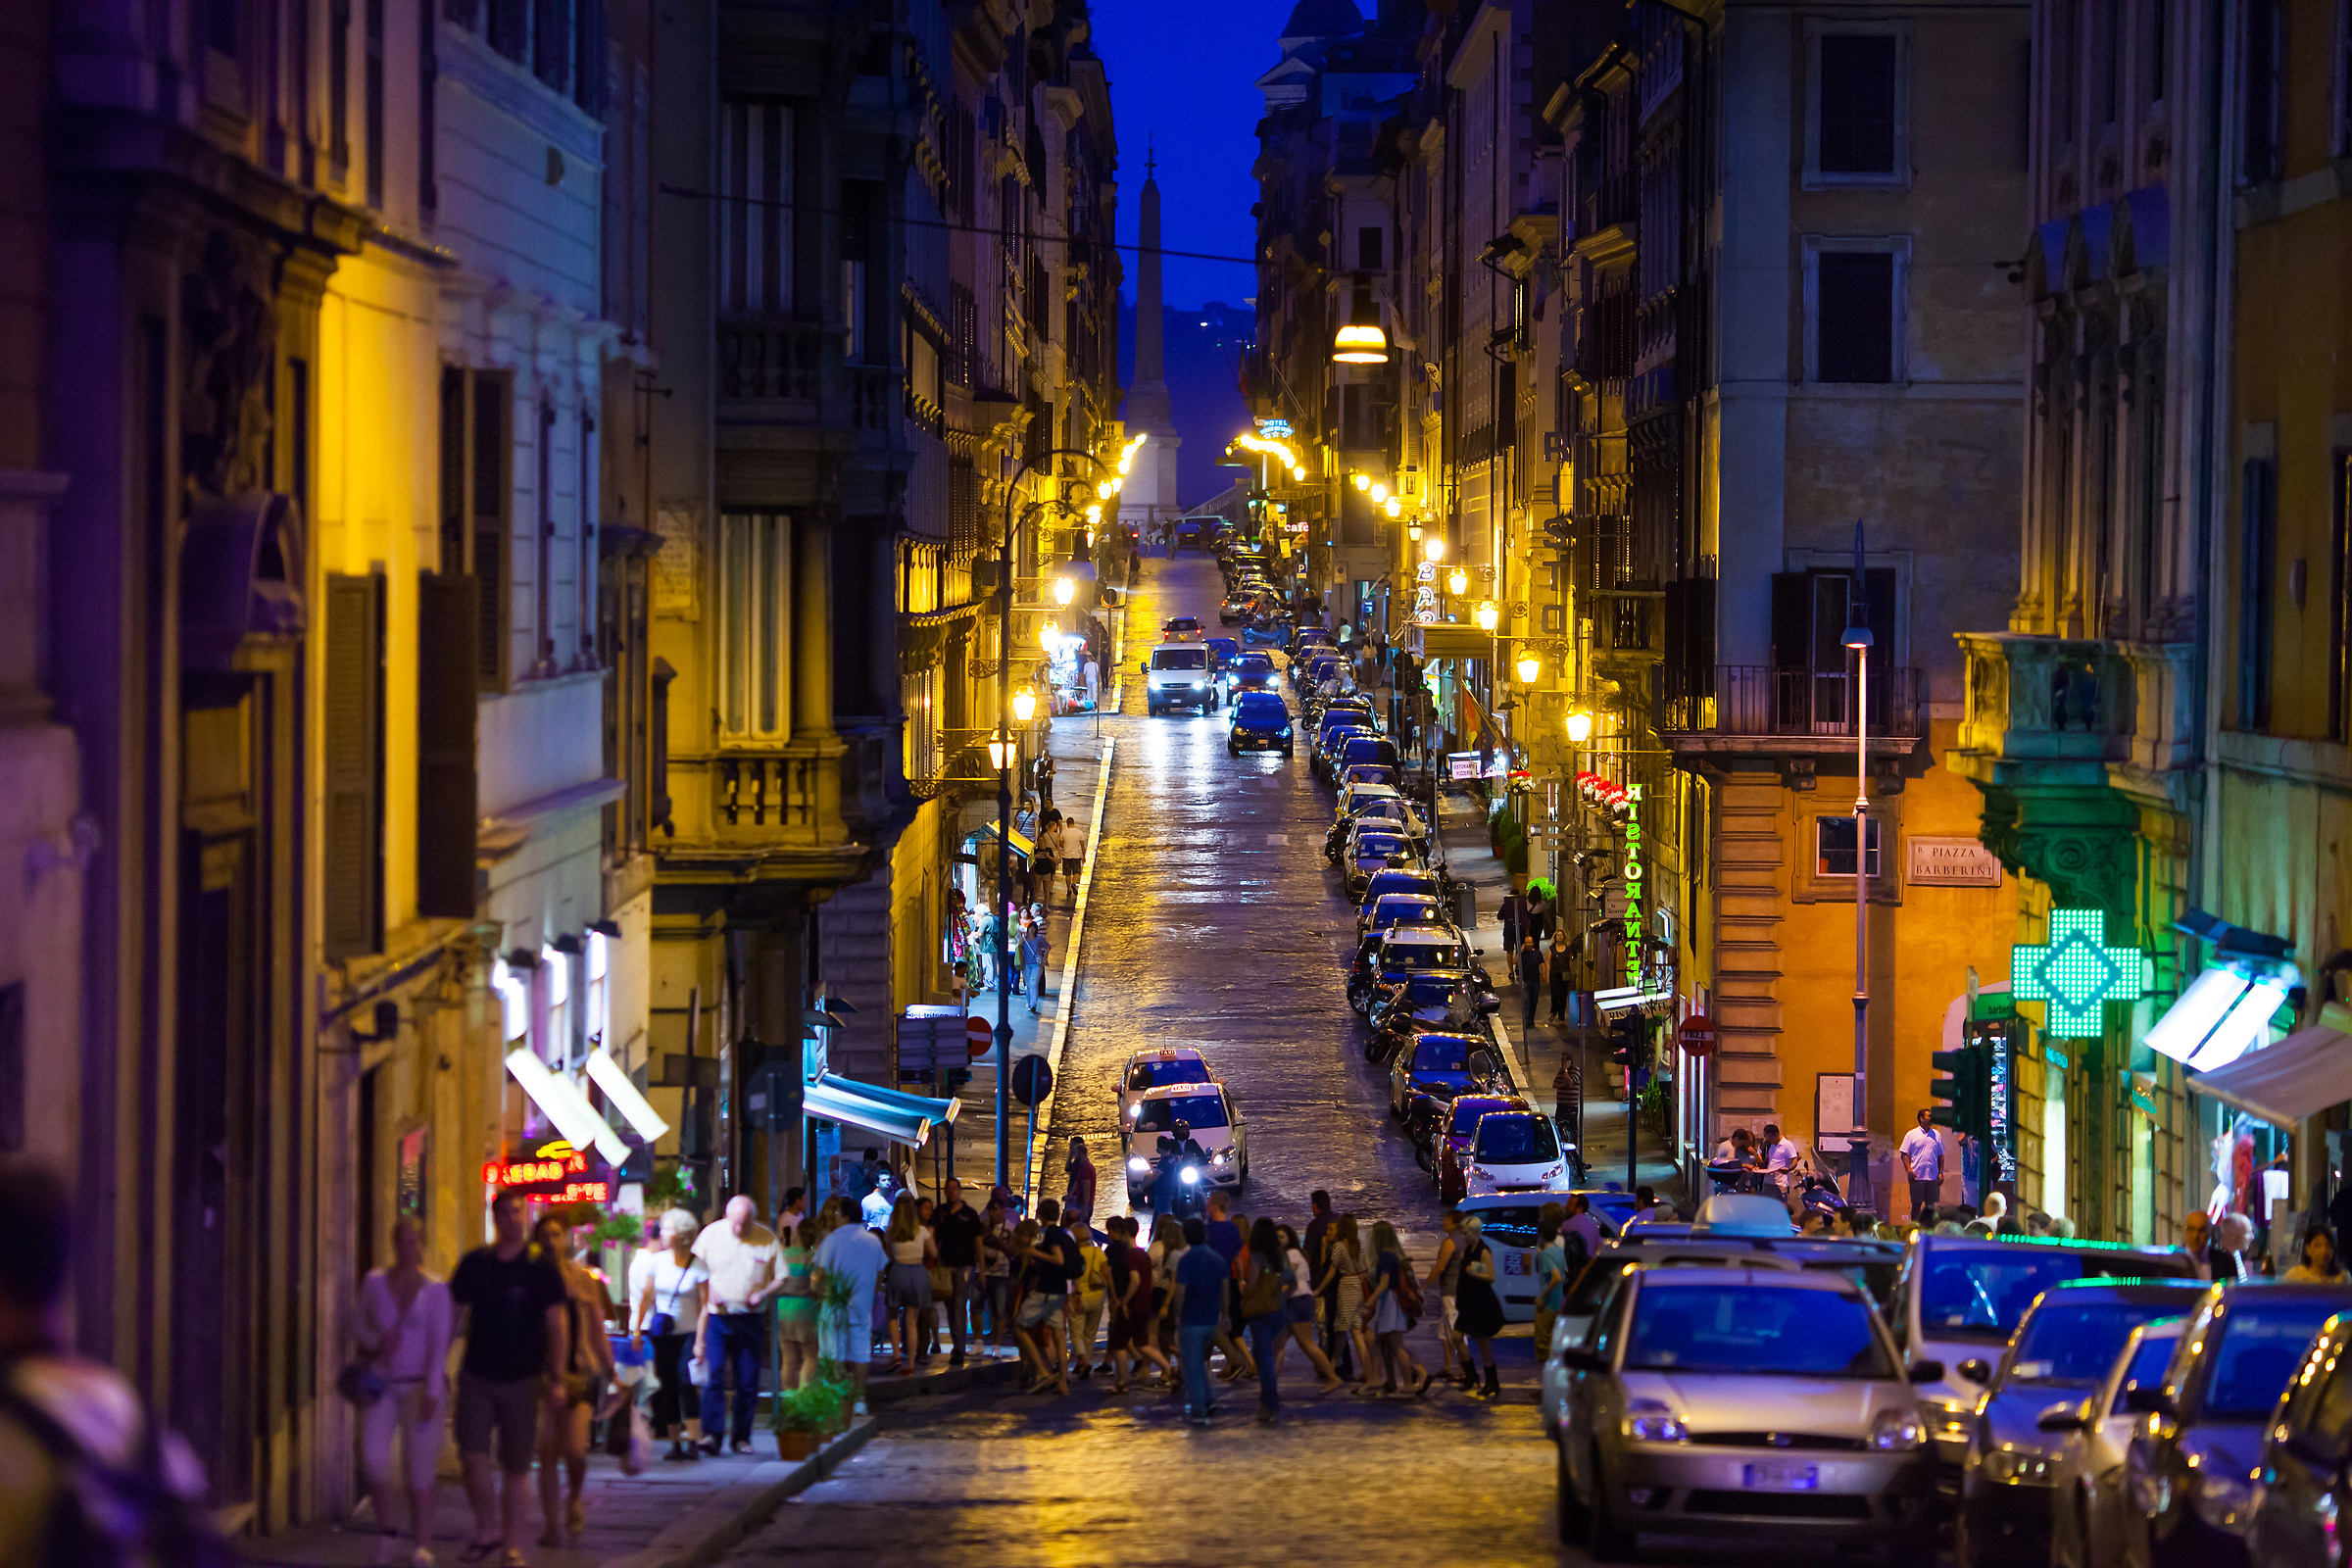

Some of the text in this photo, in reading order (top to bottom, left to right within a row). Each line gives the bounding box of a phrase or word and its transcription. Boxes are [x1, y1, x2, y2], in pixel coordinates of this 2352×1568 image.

[1933, 848, 1975, 858] PIAZZA
[1916, 865, 1991, 876] BARBERINI
[1609, 1001, 1670, 1019] RISTRANTE
[1685, 1030, 1706, 1040] FREE
